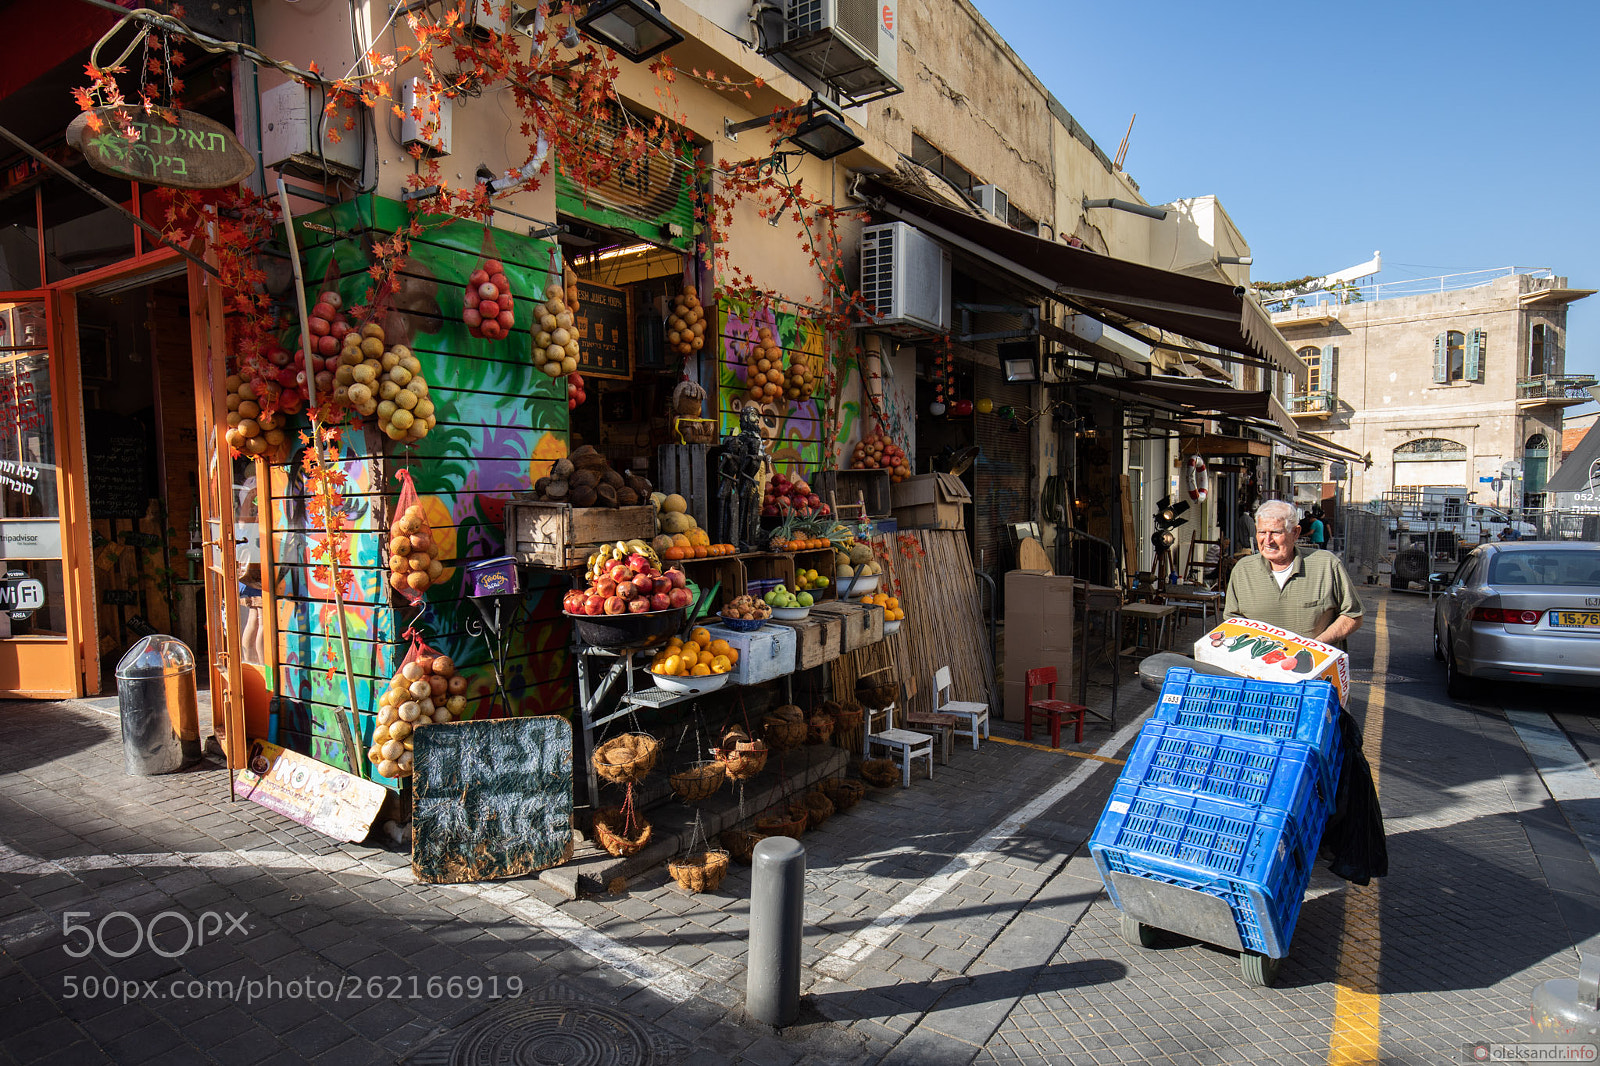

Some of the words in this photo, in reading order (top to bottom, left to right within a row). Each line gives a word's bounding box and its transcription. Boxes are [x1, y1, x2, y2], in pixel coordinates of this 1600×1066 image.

[132, 121, 226, 153] תאילנד
[577, 289, 589, 301] ESH
[590, 293, 607, 305] JUICE
[16, 464, 40, 480] ללא
[1227, 617, 1287, 637] מובחרים
